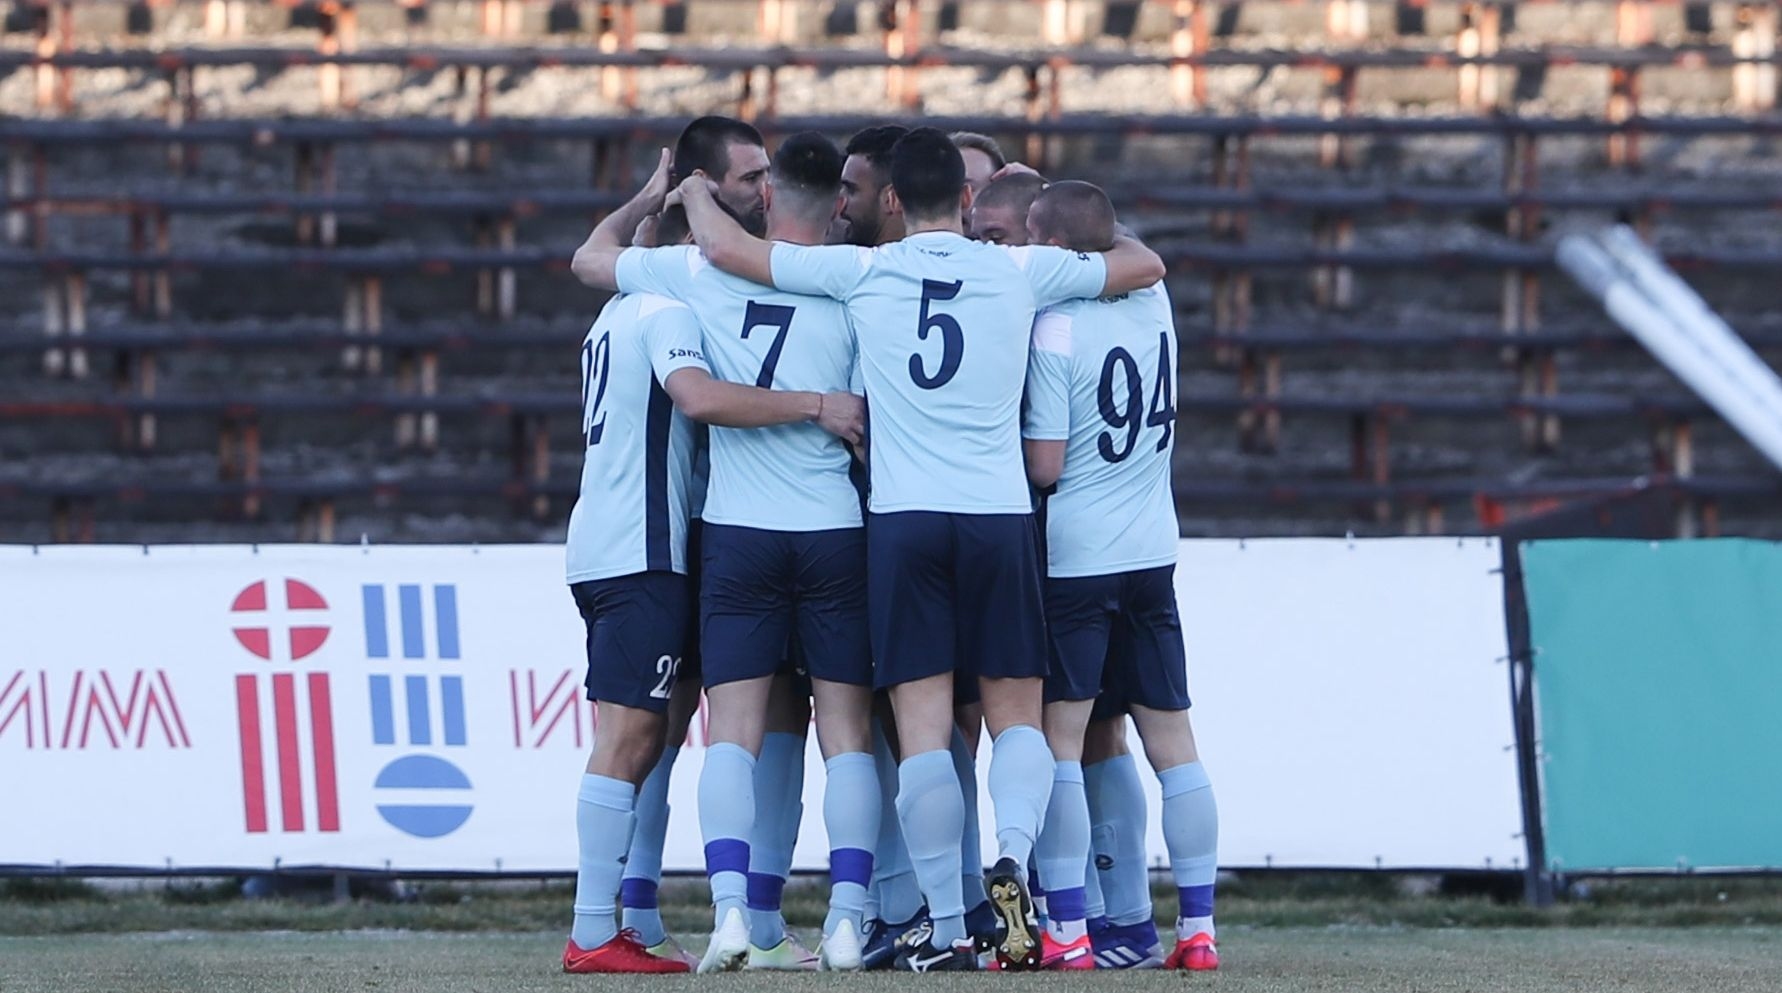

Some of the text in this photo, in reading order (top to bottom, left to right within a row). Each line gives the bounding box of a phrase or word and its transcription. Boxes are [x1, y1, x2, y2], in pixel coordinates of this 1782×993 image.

[740, 299, 797, 389] 7
[908, 278, 965, 390] 5
[1097, 331, 1177, 463] 94
